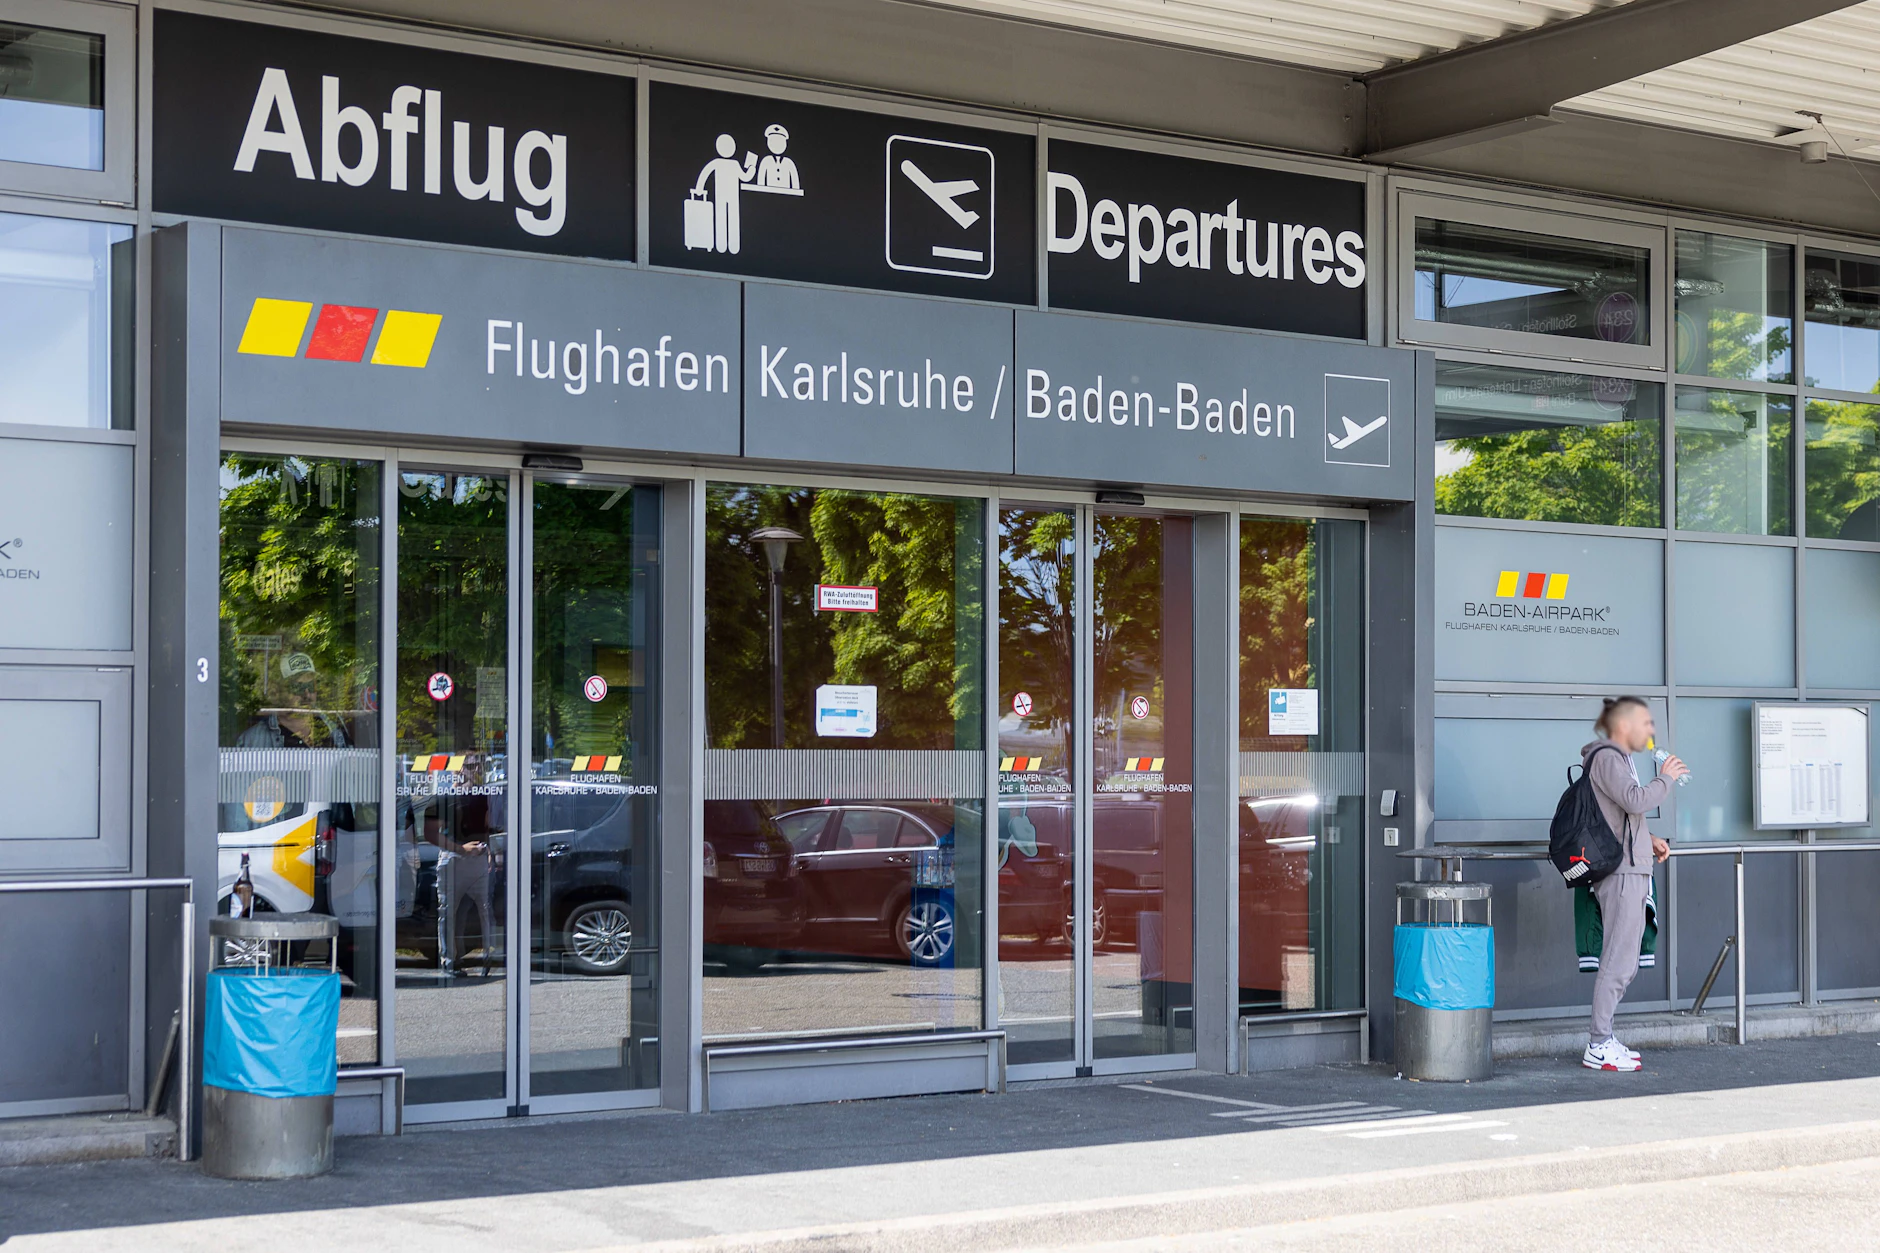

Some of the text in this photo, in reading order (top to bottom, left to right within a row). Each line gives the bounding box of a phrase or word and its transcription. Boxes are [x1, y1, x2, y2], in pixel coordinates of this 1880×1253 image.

[234, 67, 567, 237] Abflug
[1047, 171, 1366, 289] Departures
[486, 319, 729, 395] Flughafen
[760, 345, 975, 413] Karlsruhe
[1027, 368, 1295, 439] Baden-Baden
[1445, 621, 1498, 632] FLUGHAFEN
[1500, 624, 1552, 634] KARLSRUHE
[1559, 626, 1620, 636] BADEN-BADEN
[197, 657, 209, 683] 3
[410, 774, 465, 784] FLUGHAFEN
[570, 774, 622, 783] FLUGHAFEN
[998, 773, 1041, 783] FLUGHAFEN
[1123, 773, 1165, 782] FLUGHAFEN
[395, 785, 503, 796] SRUHE BADEN-BADEN
[535, 785, 658, 795] KARLSRUHE BADEN-BADEN
[1019, 784, 1072, 793] BADEN-BADEN
[1096, 784, 1193, 793] KARLSRUHE BADEN-BADEN
